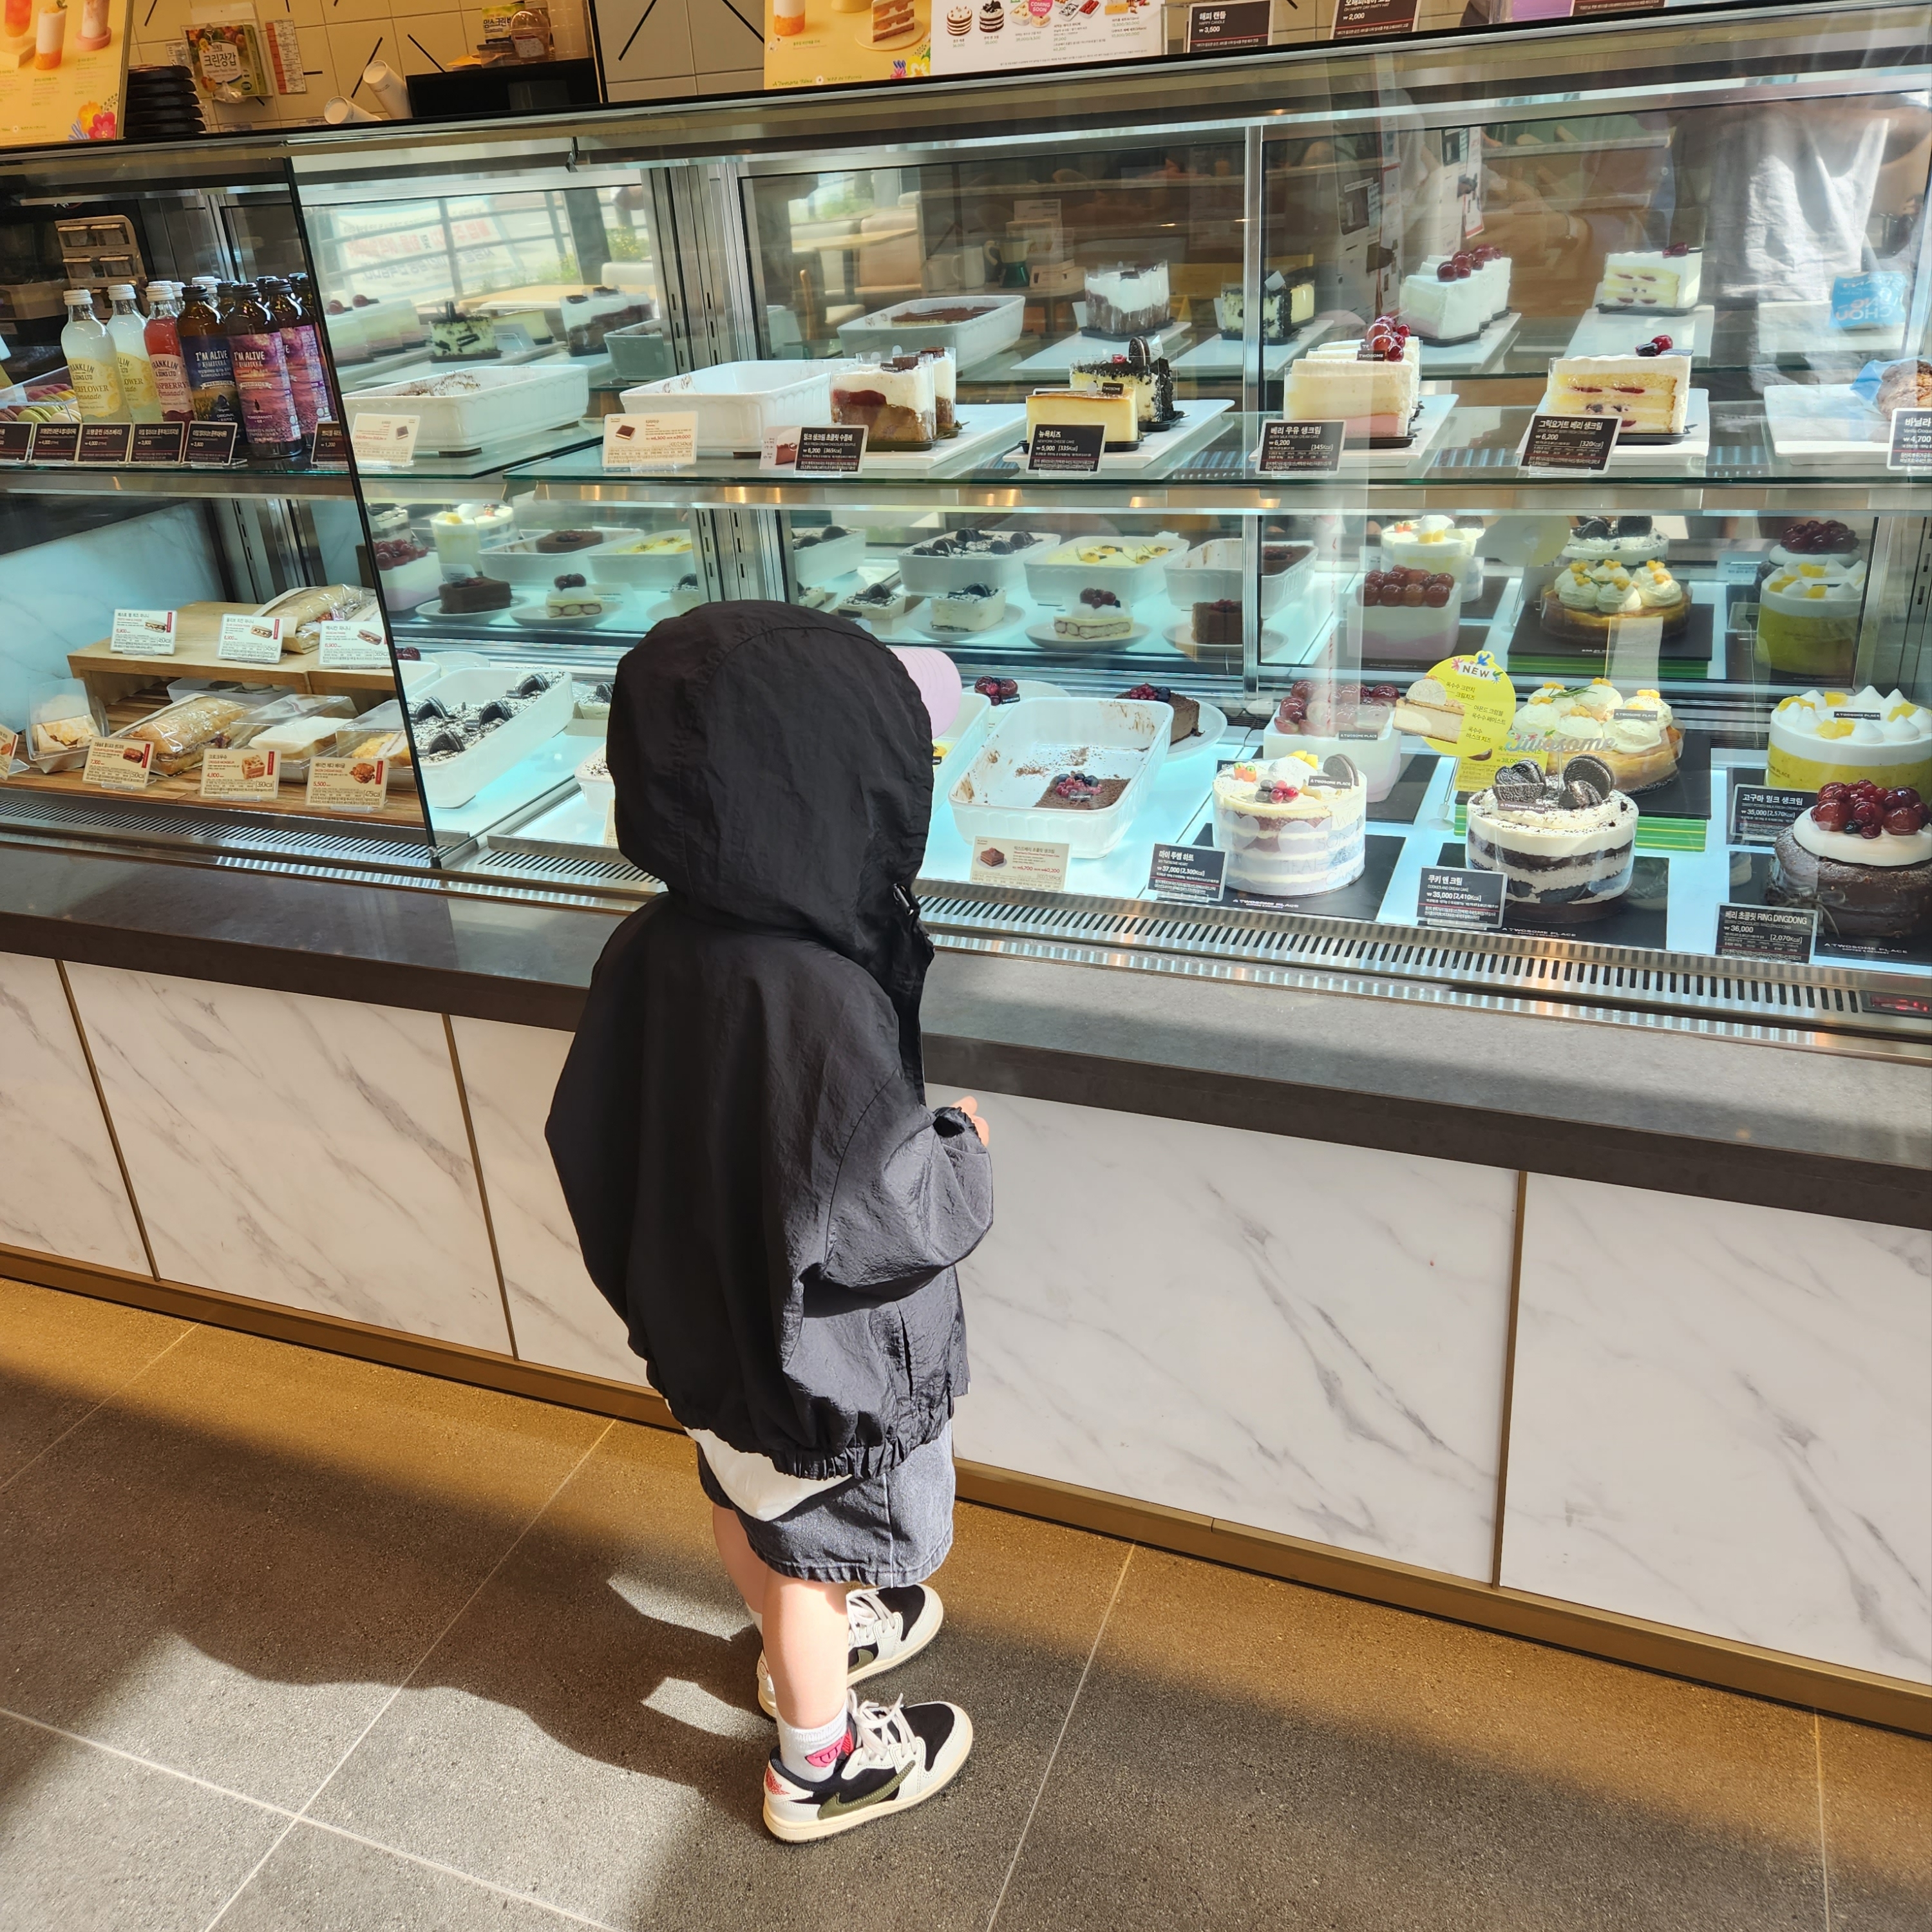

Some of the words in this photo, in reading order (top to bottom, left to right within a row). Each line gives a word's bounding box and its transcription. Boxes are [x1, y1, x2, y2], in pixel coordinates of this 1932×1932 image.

[1213, 11, 1226, 20] 캔들
[204, 52, 236, 67] 크린장갑
[195, 351, 209, 361] I'M
[210, 350, 228, 360] ALIVE
[234, 352, 245, 361] I'M
[245, 352, 265, 361] ALIVE
[1538, 420, 1569, 429] 그릭요거트
[1570, 421, 1584, 430] 베리
[1584, 421, 1603, 430] 생크림
[1905, 417, 1931, 427] 바닐라
[1038, 430, 1061, 439] 뉴욕치즈
[1285, 426, 1300, 435] 우유
[1301, 426, 1321, 435] 생크림
[1463, 665, 1490, 677] NEW
[1455, 692, 1475, 700] 크림치즈
[1486, 716, 1506, 725] 페이스트
[1505, 729, 1618, 752] Twosome
[1742, 793, 1764, 802] 고구마
[1781, 796, 1803, 806] 생크림
[1159, 850, 1170, 859] 마이
[1428, 875, 1441, 884] 쿠키
[1442, 876, 1449, 885] 앤
[1449, 877, 1463, 886] 크림
[1725, 911, 1738, 920] 베리
[1738, 911, 1756, 922] 초콜릿
[1757, 913, 1772, 922] RING
[1773, 914, 1807, 925] DINGDONG
